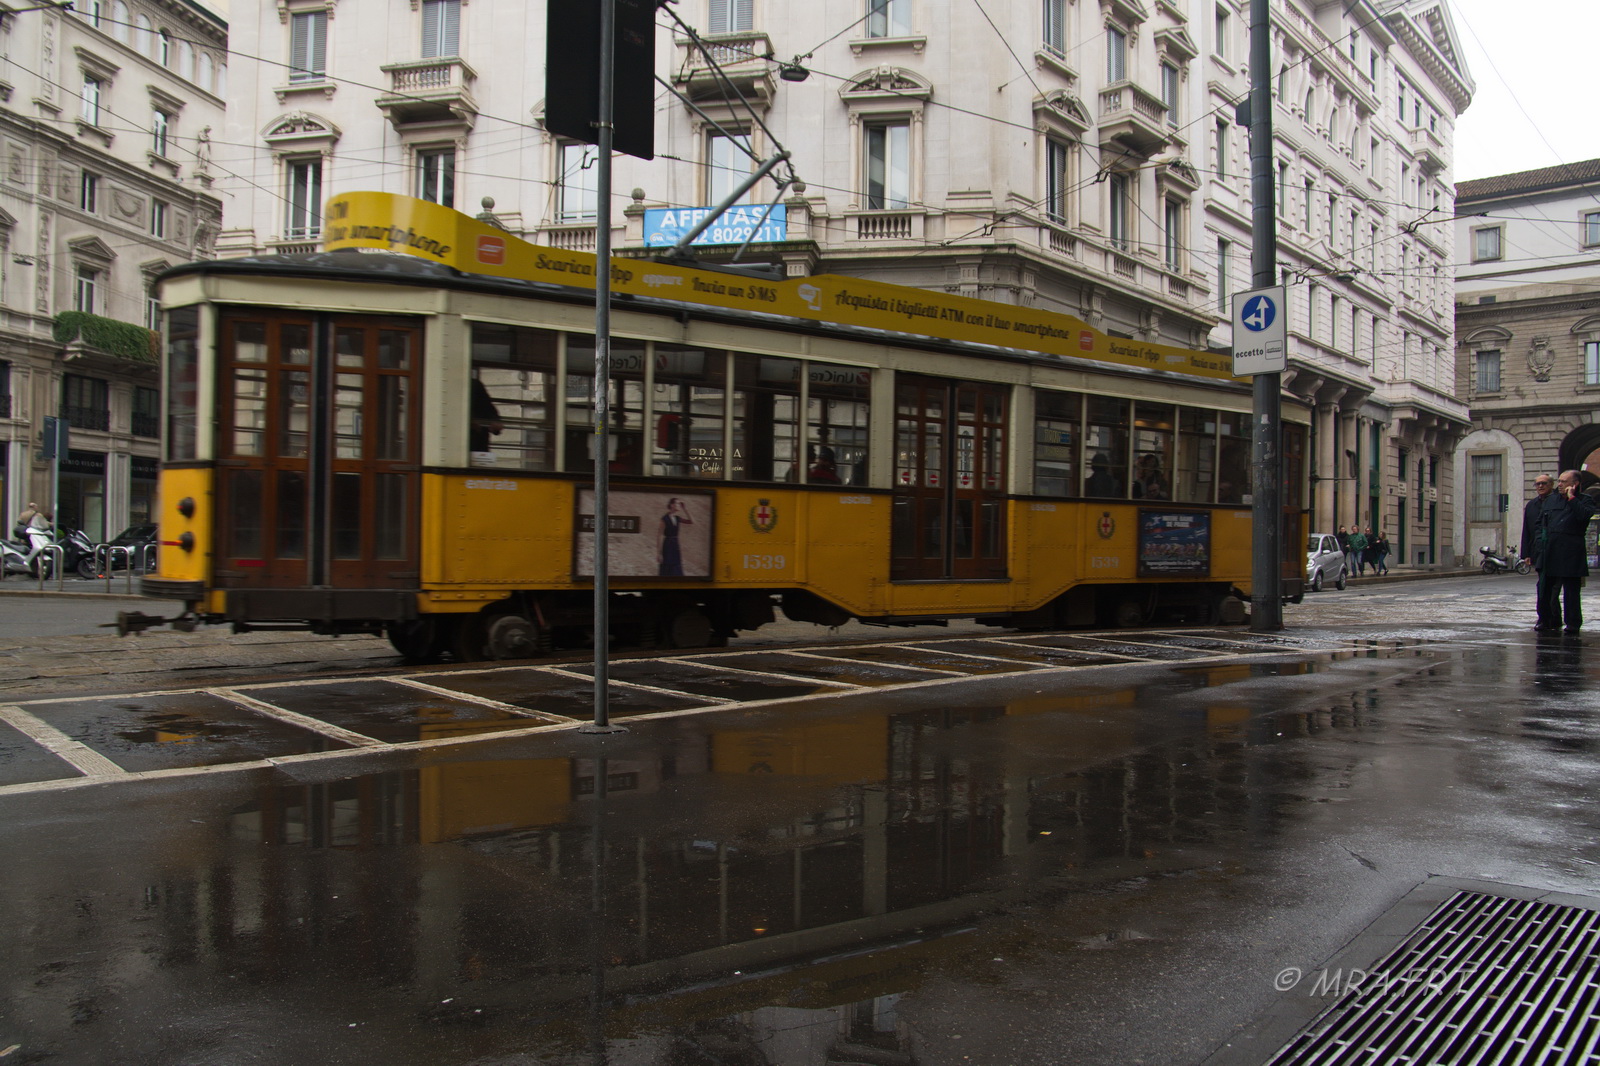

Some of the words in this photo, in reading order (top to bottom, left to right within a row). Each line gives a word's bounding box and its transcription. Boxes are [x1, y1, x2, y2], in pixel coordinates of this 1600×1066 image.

[713, 226, 780, 243] 8029211
[535, 253, 591, 276] Scarica
[746, 285, 777, 302] SMS
[835, 289, 887, 311] Acquista
[890, 298, 895, 312] i
[896, 299, 938, 319] biglietti
[940, 307, 964, 323] ATM
[966, 316, 984, 327] con
[985, 314, 993, 328] il
[994, 316, 1011, 330] tuo
[1013, 321, 1070, 340] smartphone
[1235, 348, 1264, 359] eccetto
[743, 554, 786, 570] 1539
[1091, 556, 1120, 569] 1539
